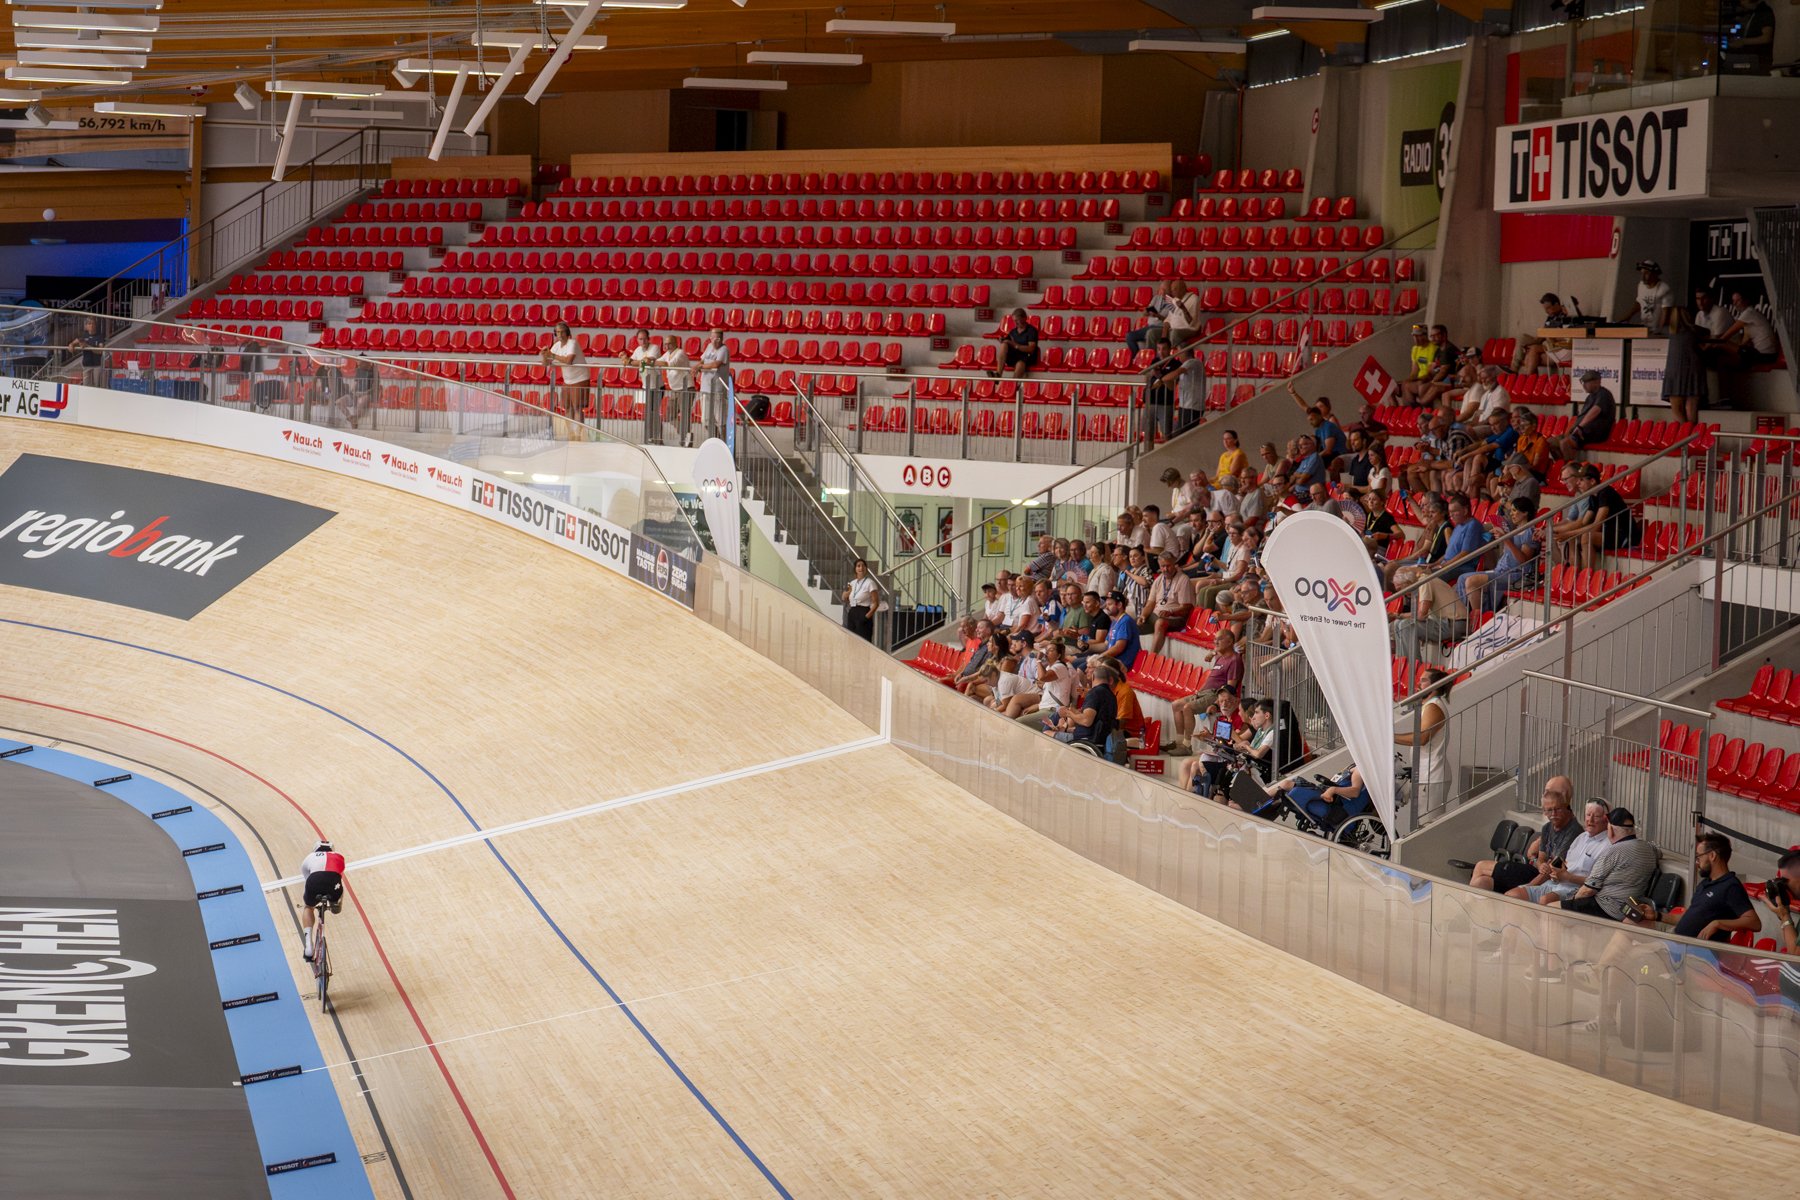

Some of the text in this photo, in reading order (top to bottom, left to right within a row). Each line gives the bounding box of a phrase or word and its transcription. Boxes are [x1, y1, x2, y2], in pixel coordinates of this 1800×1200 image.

[79, 117, 166, 131] 56,792 km/h
[1403, 142, 1432, 174] RADIO
[1556, 107, 1688, 199] TISSOT
[12, 379, 39, 391] KÄLTE
[16, 391, 39, 416] AG
[293, 432, 323, 449] Nau.ch
[343, 443, 372, 461] Nau.ch
[391, 456, 419, 474] Nau.ch
[436, 469, 463, 488] Nau.ch
[496, 485, 555, 531] TISSOT
[0, 510, 244, 577] regiobank
[578, 517, 629, 565] TISSOT
[636, 555, 655, 573] TASTE
[671, 564, 688, 583] ZERO
[0, 907, 157, 1067] GRENCHEN
[250, 1074, 269, 1082] TISSOT
[277, 1162, 300, 1170] TISSOT
